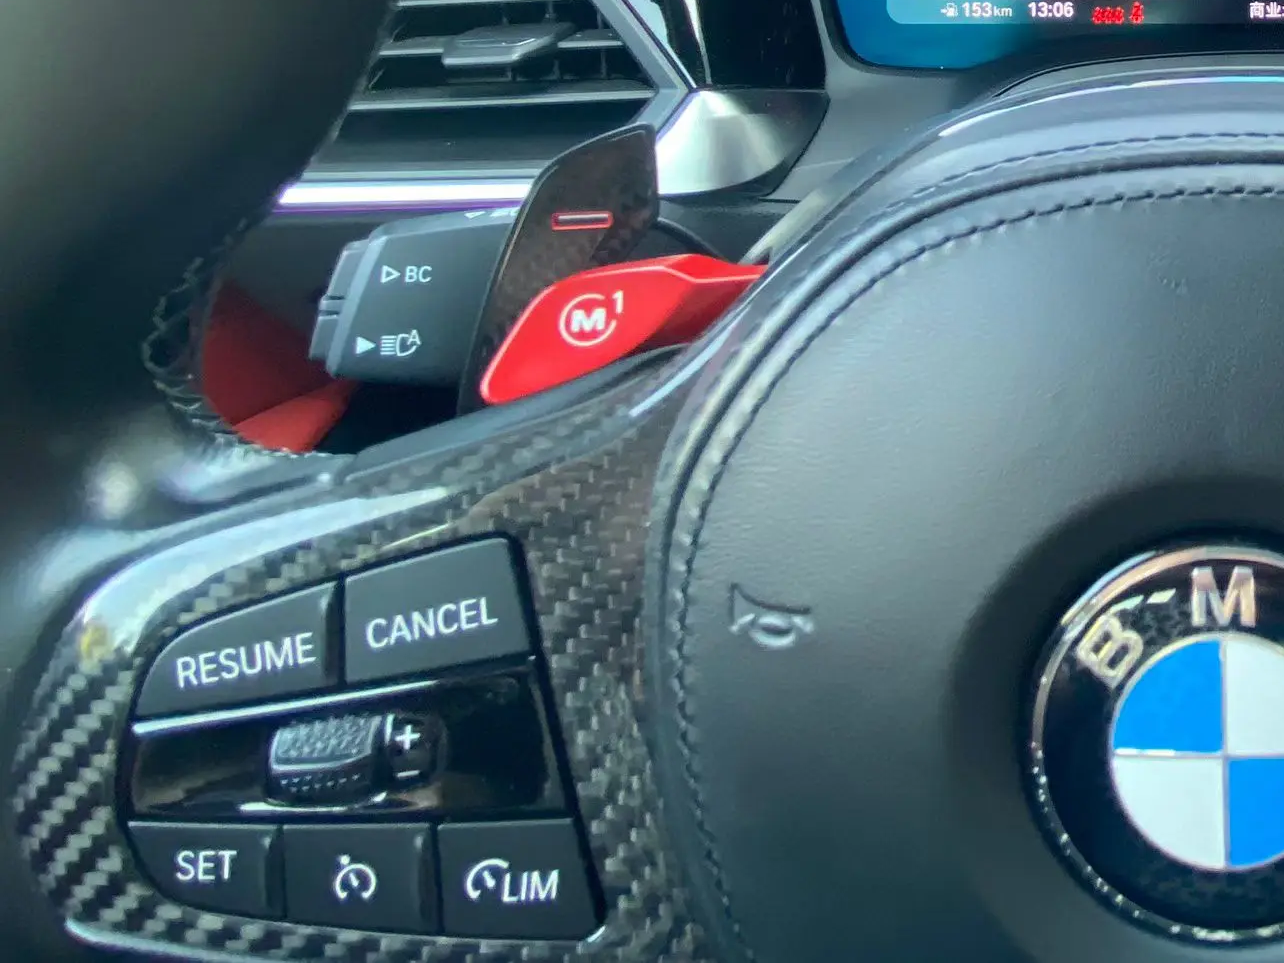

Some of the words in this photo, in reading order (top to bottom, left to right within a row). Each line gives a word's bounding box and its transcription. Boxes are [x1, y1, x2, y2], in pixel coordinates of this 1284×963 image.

[962, 2, 992, 17] 153
[993, 3, 1013, 17] km
[1028, 2, 1075, 18] 13:06
[405, 265, 432, 283] BC
[366, 597, 498, 650] CANCEL
[176, 631, 316, 689] RESUME
[175, 850, 237, 882] SET
[502, 869, 559, 903] LIM
